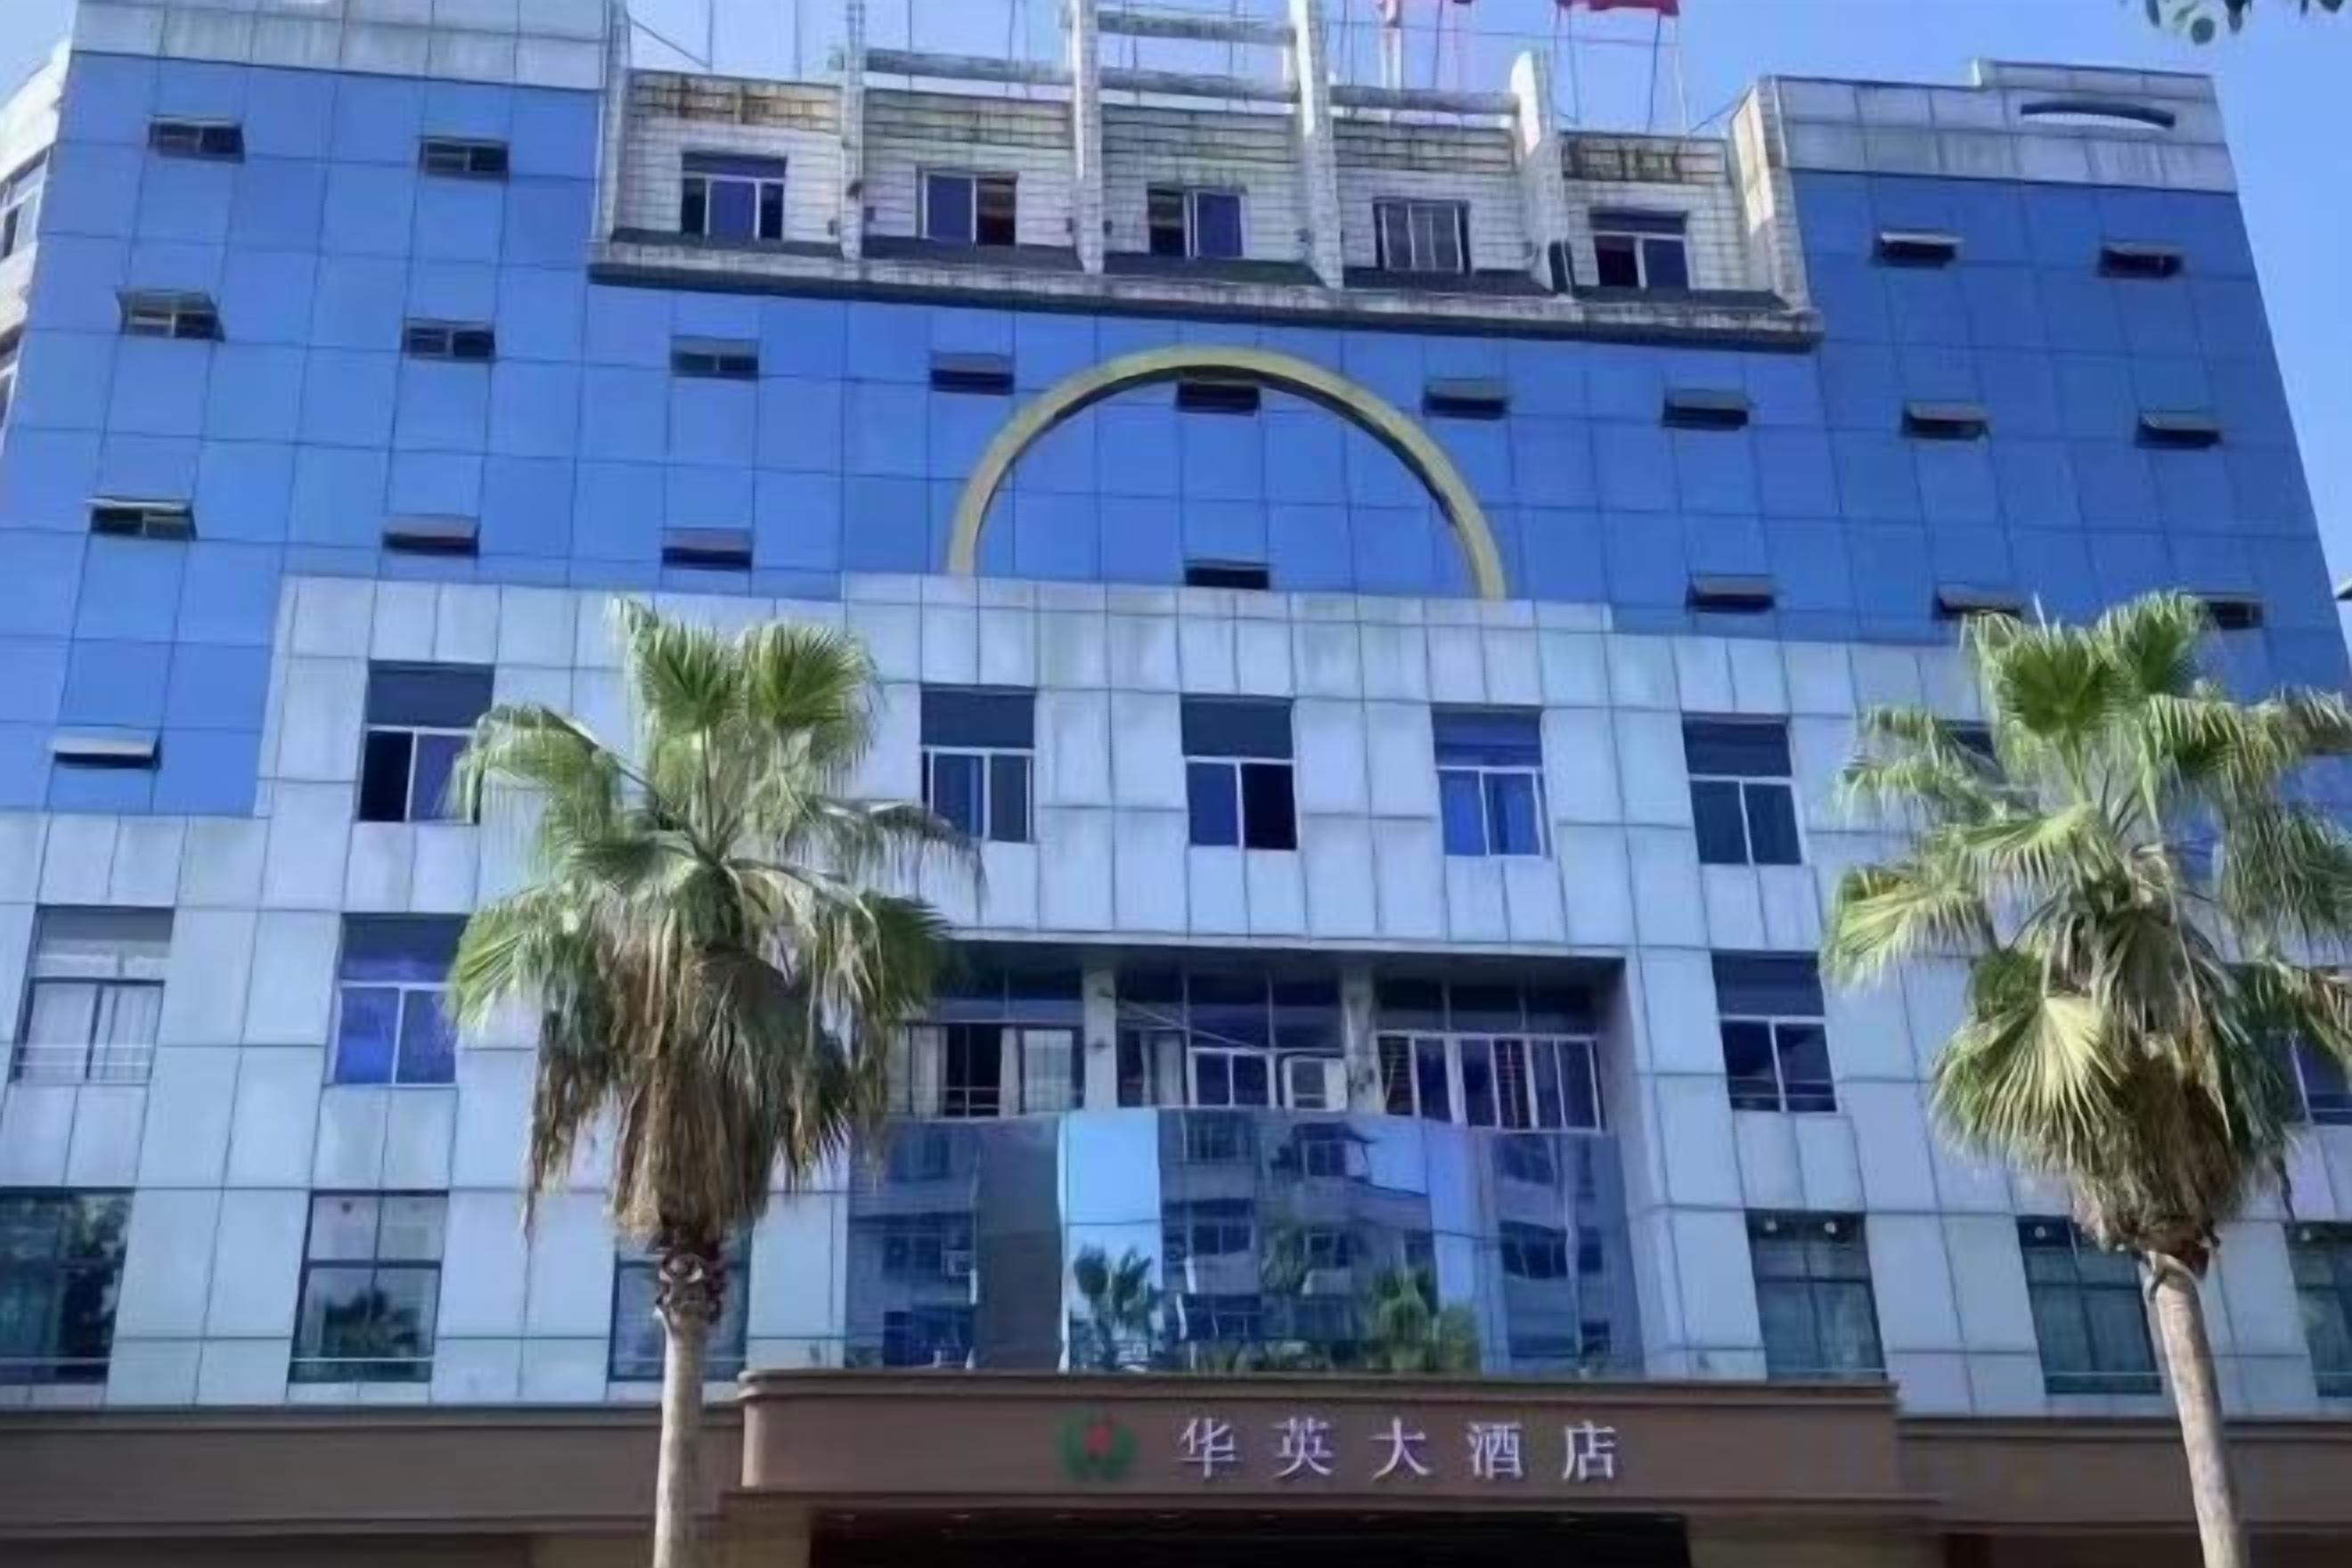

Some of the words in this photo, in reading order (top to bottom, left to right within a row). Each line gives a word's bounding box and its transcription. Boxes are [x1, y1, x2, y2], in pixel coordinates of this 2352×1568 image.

[1180, 1416, 1618, 1480] 华英大酒店
